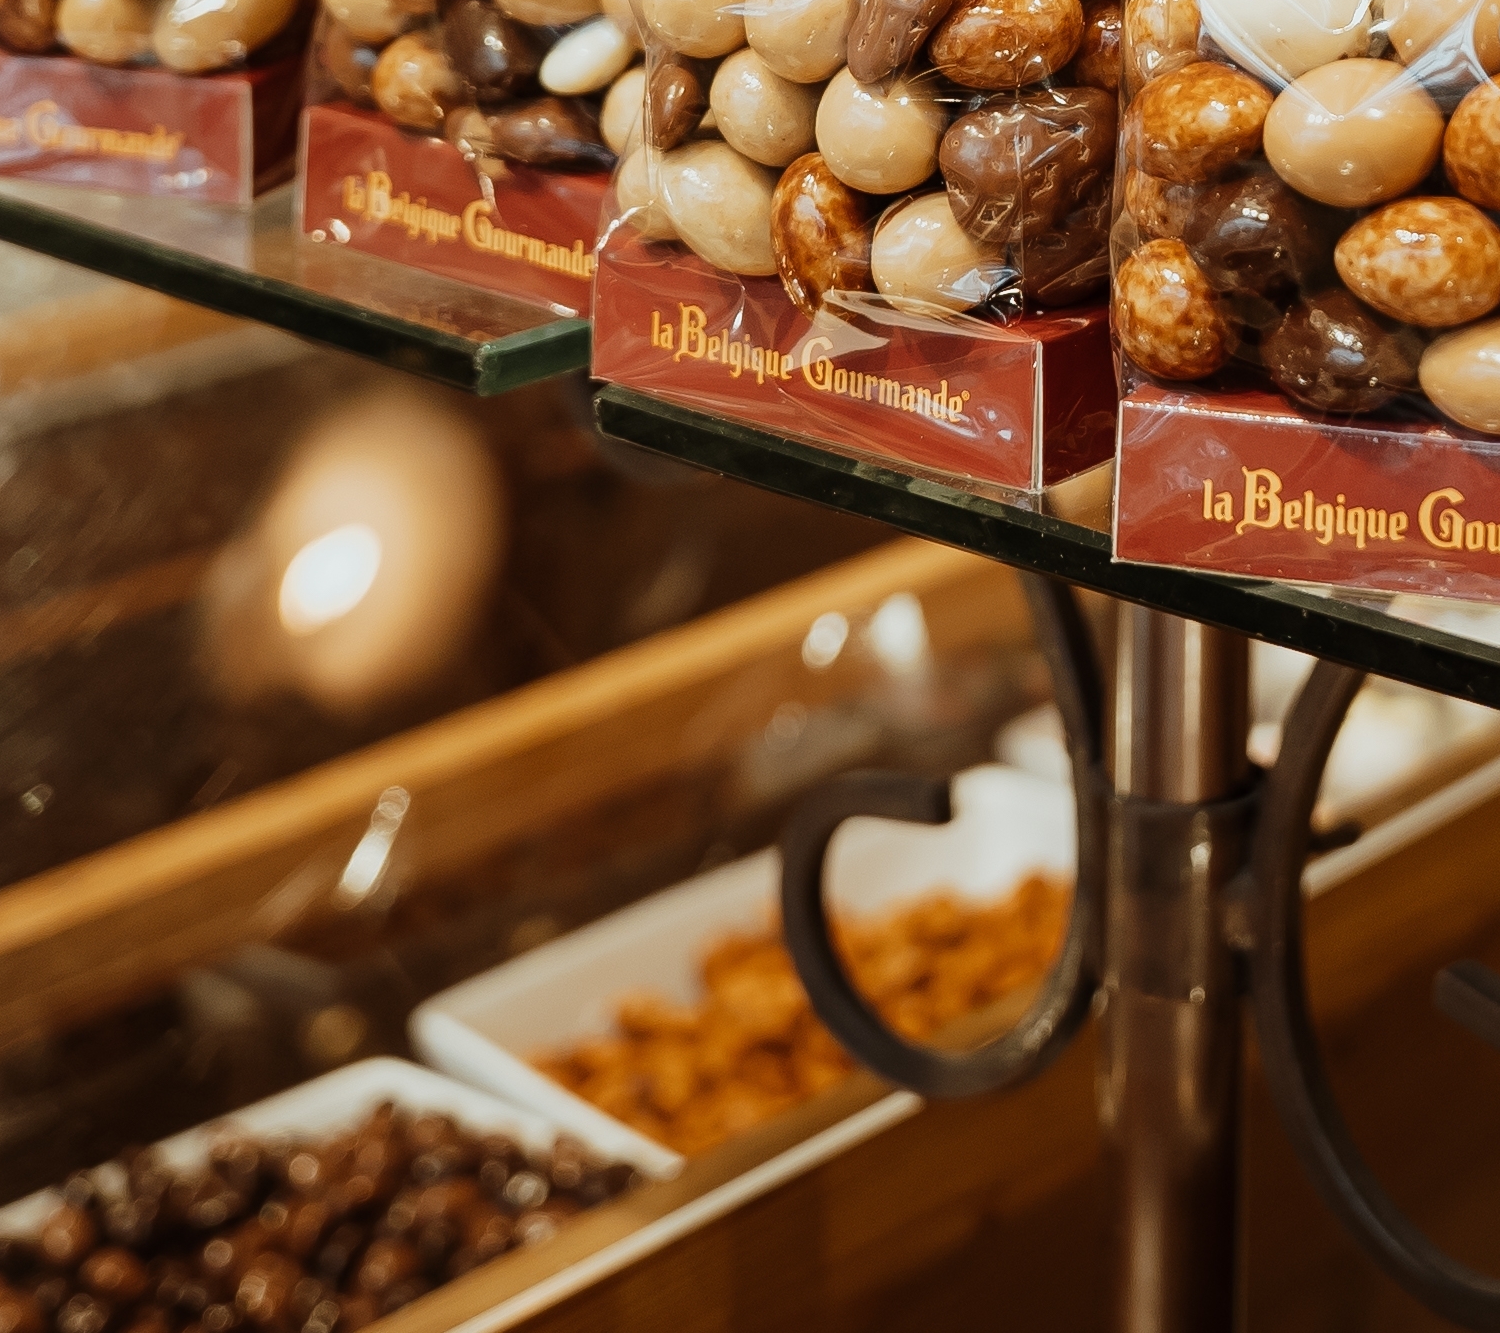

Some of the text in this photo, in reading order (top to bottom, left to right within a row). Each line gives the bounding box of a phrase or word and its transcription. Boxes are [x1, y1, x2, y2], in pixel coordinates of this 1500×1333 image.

[651, 301, 964, 423] la Belgique Gourmande
[1201, 478, 1235, 522] la
[1234, 465, 1409, 549] Belgique
